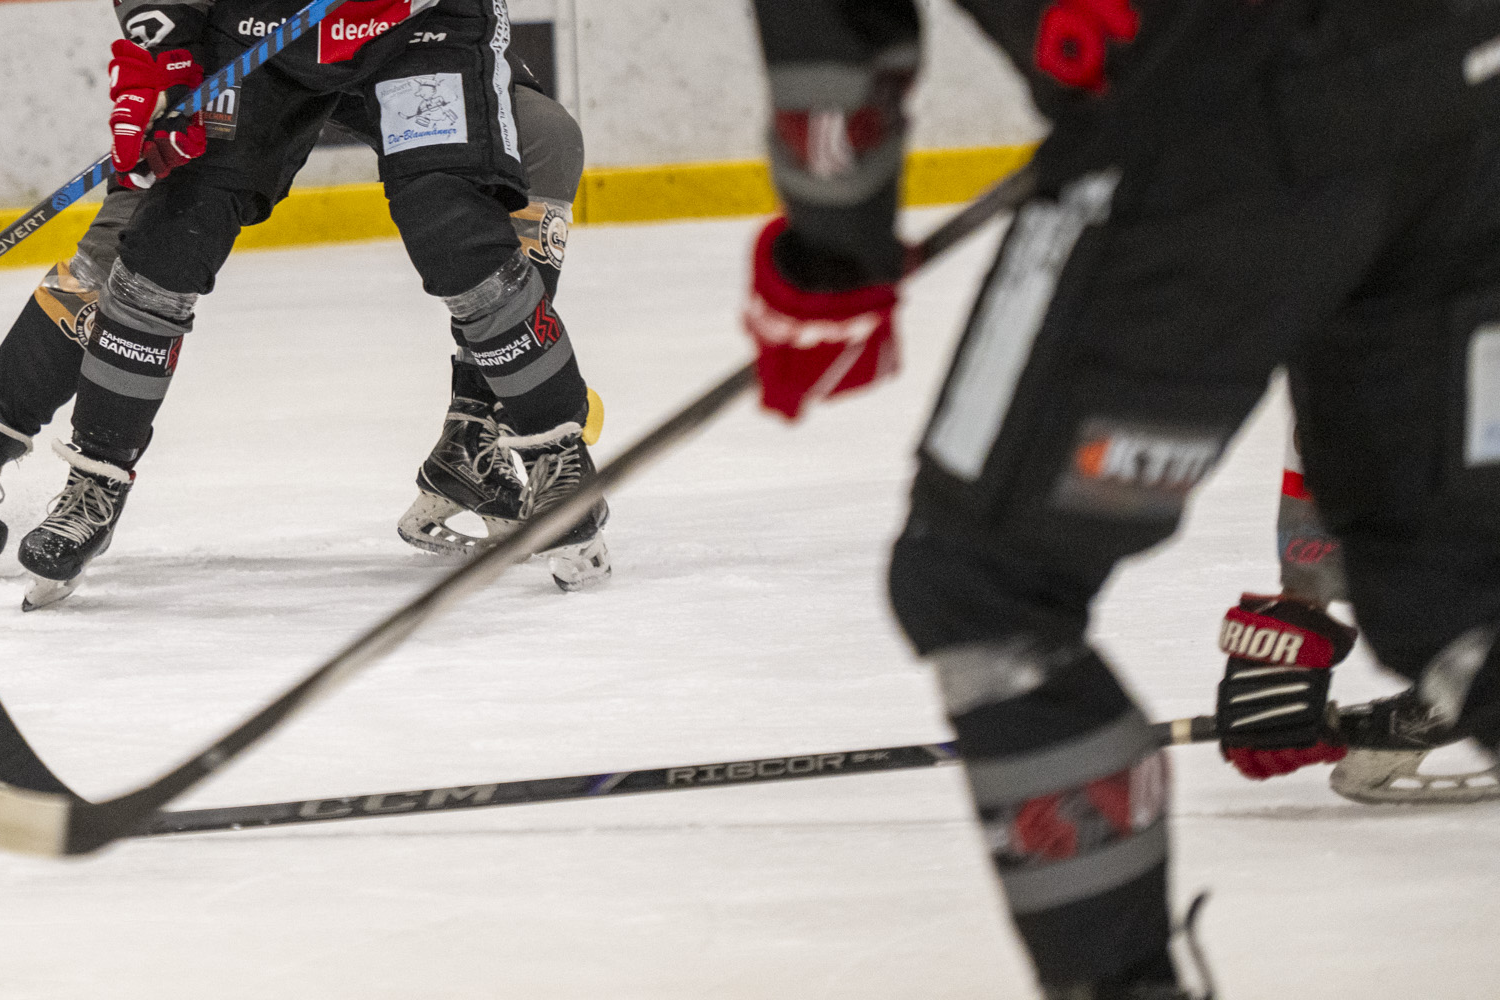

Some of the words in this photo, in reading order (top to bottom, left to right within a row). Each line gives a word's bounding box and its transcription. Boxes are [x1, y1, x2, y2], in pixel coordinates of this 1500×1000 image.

[166, 61, 191, 71] CCM
[203, 113, 232, 121] ECHNIK
[99, 336, 166, 365] BANNAT
[102, 329, 167, 356] FAHRSCHULE
[666, 752, 844, 785] RIBCOR
[299, 782, 498, 819] CCM
